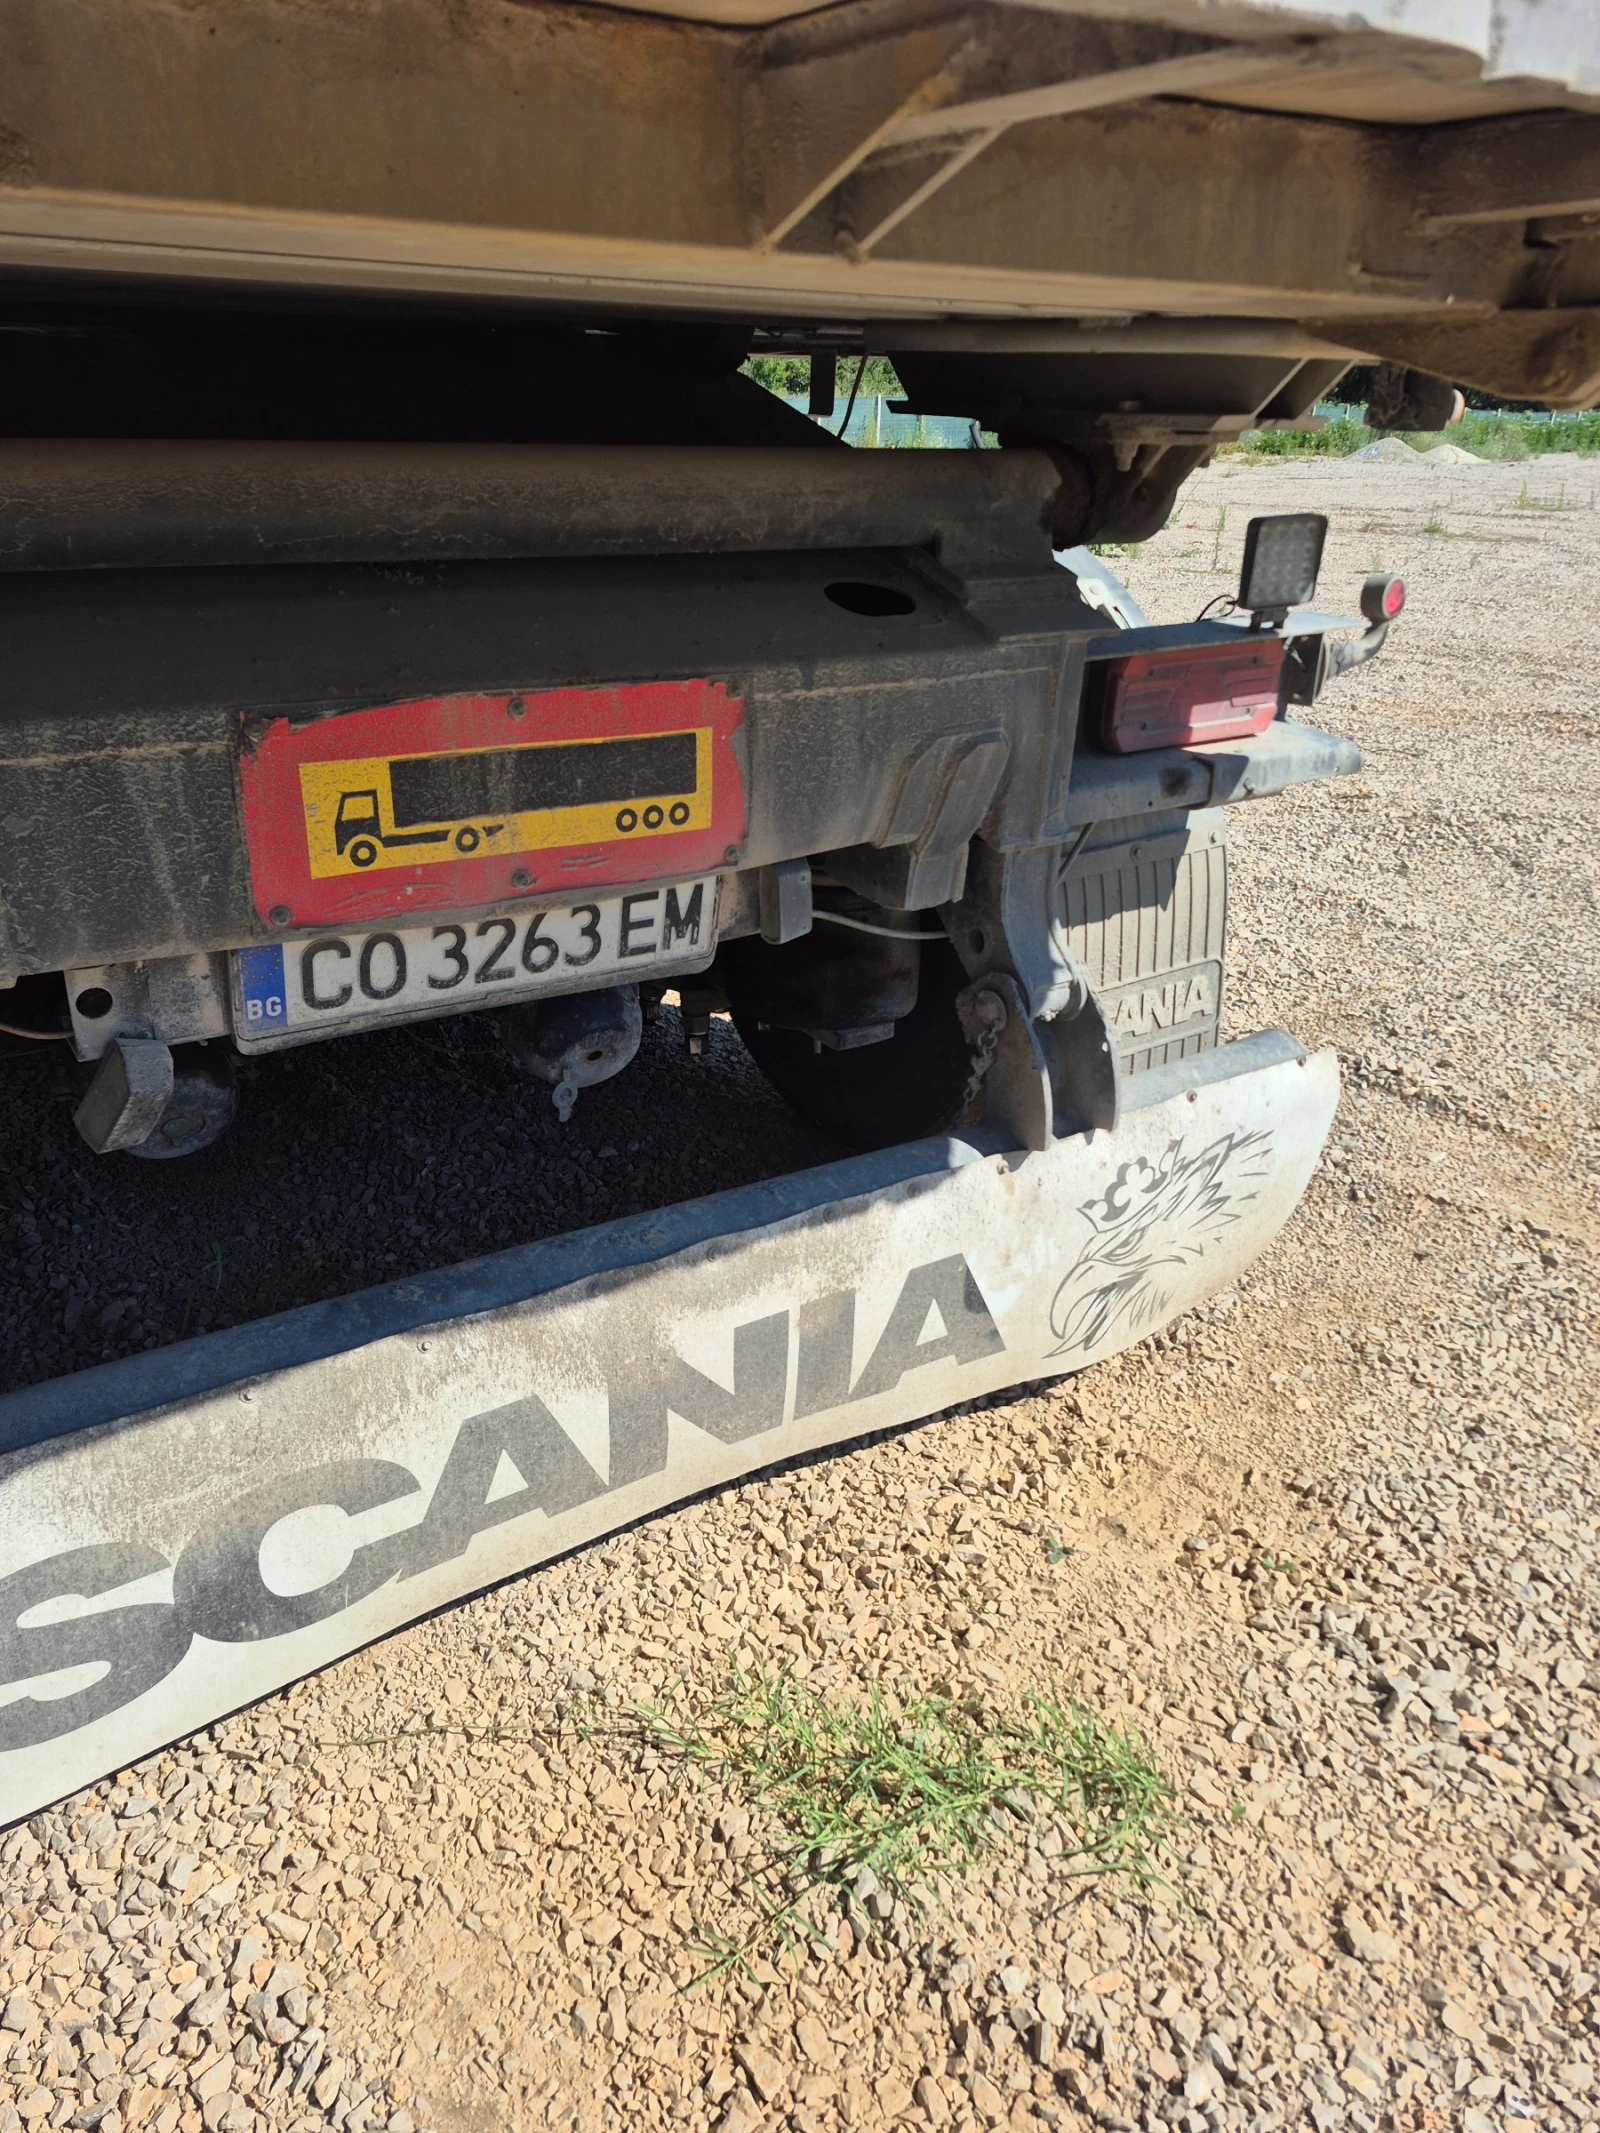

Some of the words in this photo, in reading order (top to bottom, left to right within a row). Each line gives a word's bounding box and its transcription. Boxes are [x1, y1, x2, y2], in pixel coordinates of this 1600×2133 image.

[302, 931, 407, 1010] CO
[427, 903, 601, 990] 3263
[618, 883, 704, 959] EM
[247, 997, 282, 1020] BG
[1109, 975, 1213, 1037] ANIA
[0, 1253, 1006, 1752] SCANIA
